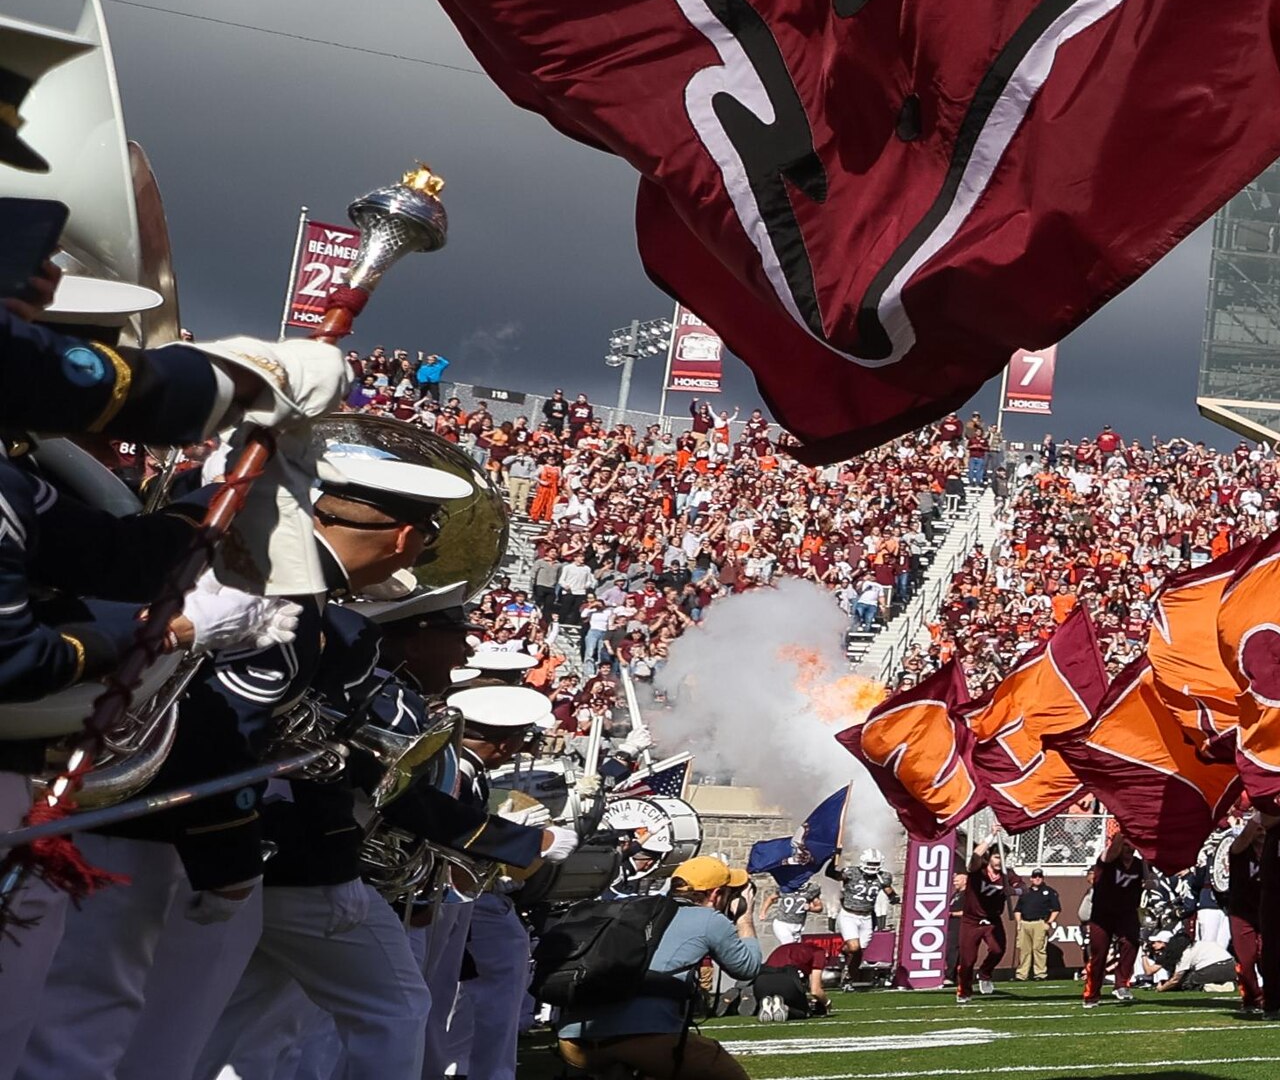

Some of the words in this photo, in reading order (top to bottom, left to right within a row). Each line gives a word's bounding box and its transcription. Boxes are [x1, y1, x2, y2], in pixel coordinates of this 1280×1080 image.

[324, 229, 354, 242] VT
[294, 311, 326, 323] HOK
[1020, 356, 1044, 386] 7
[673, 377, 719, 388] HOKIES
[1009, 400, 1050, 410] HOKIES
[637, 802, 664, 824] TECH
[1114, 870, 1139, 888] VT
[980, 881, 1004, 897] VT
[783, 897, 808, 915] 92
[909, 844, 950, 979] HOKIES
